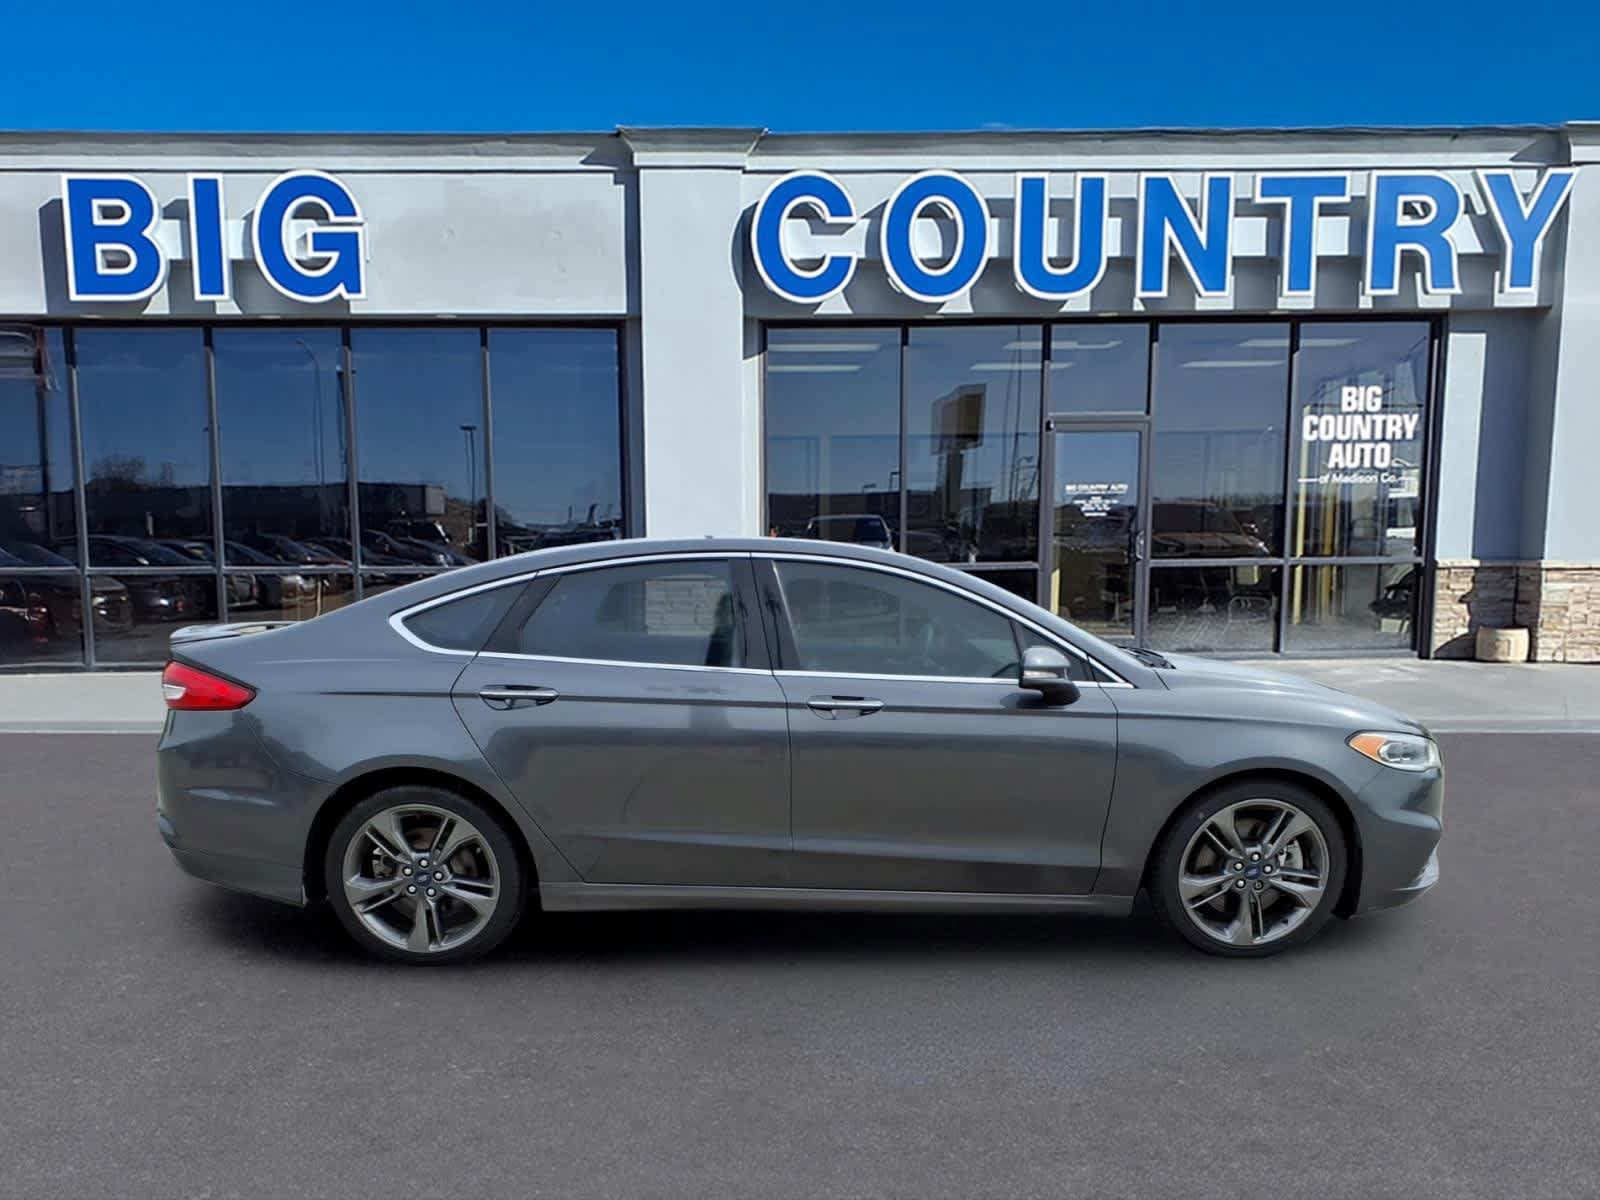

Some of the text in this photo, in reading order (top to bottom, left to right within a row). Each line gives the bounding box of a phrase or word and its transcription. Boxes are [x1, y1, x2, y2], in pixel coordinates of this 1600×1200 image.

[60, 168, 1575, 303] BIG COUNTRY
[1341, 385, 1382, 412] BIG
[1303, 414, 1419, 440] COUNTRY
[1328, 442, 1391, 469] AUTO
[1331, 473, 1378, 484] Madison
